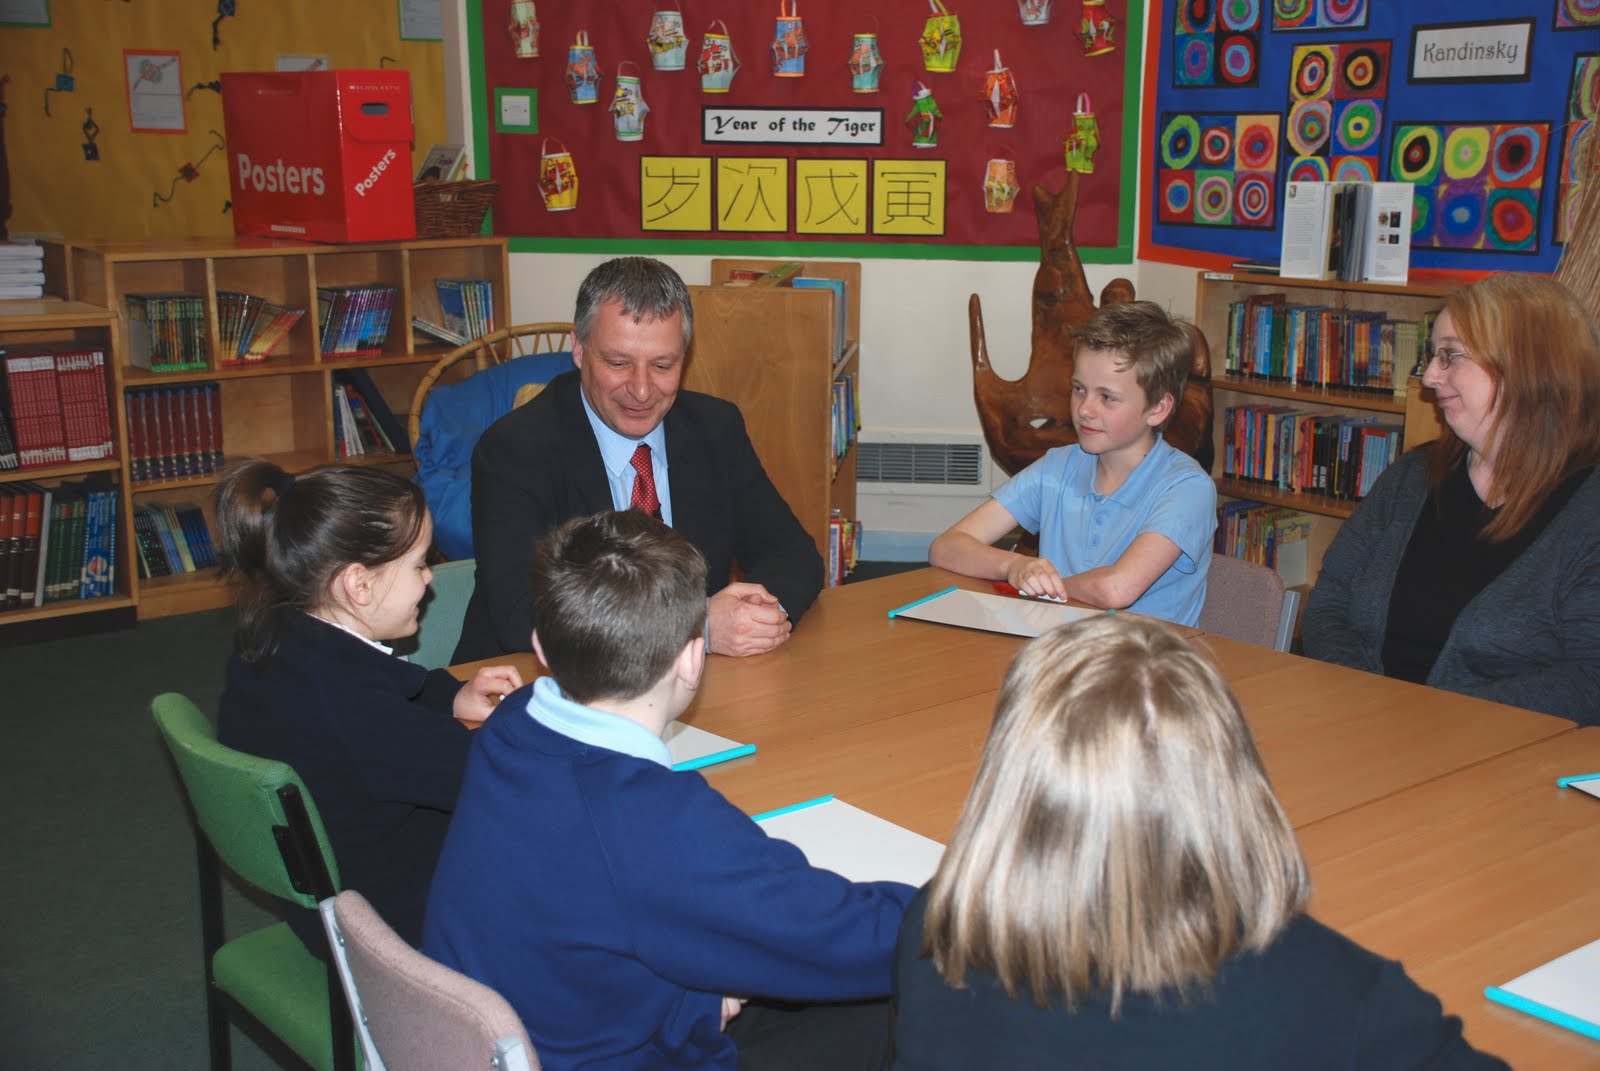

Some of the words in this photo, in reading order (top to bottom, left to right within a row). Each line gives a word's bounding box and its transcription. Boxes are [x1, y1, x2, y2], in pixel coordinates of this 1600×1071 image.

[1423, 40, 1518, 64] Kandinsky
[711, 115, 758, 135] Year
[768, 116, 787, 134] of
[792, 118, 816, 132] the
[827, 117, 876, 136] Tiger
[237, 153, 325, 196] Posters
[354, 148, 397, 197] Posters
